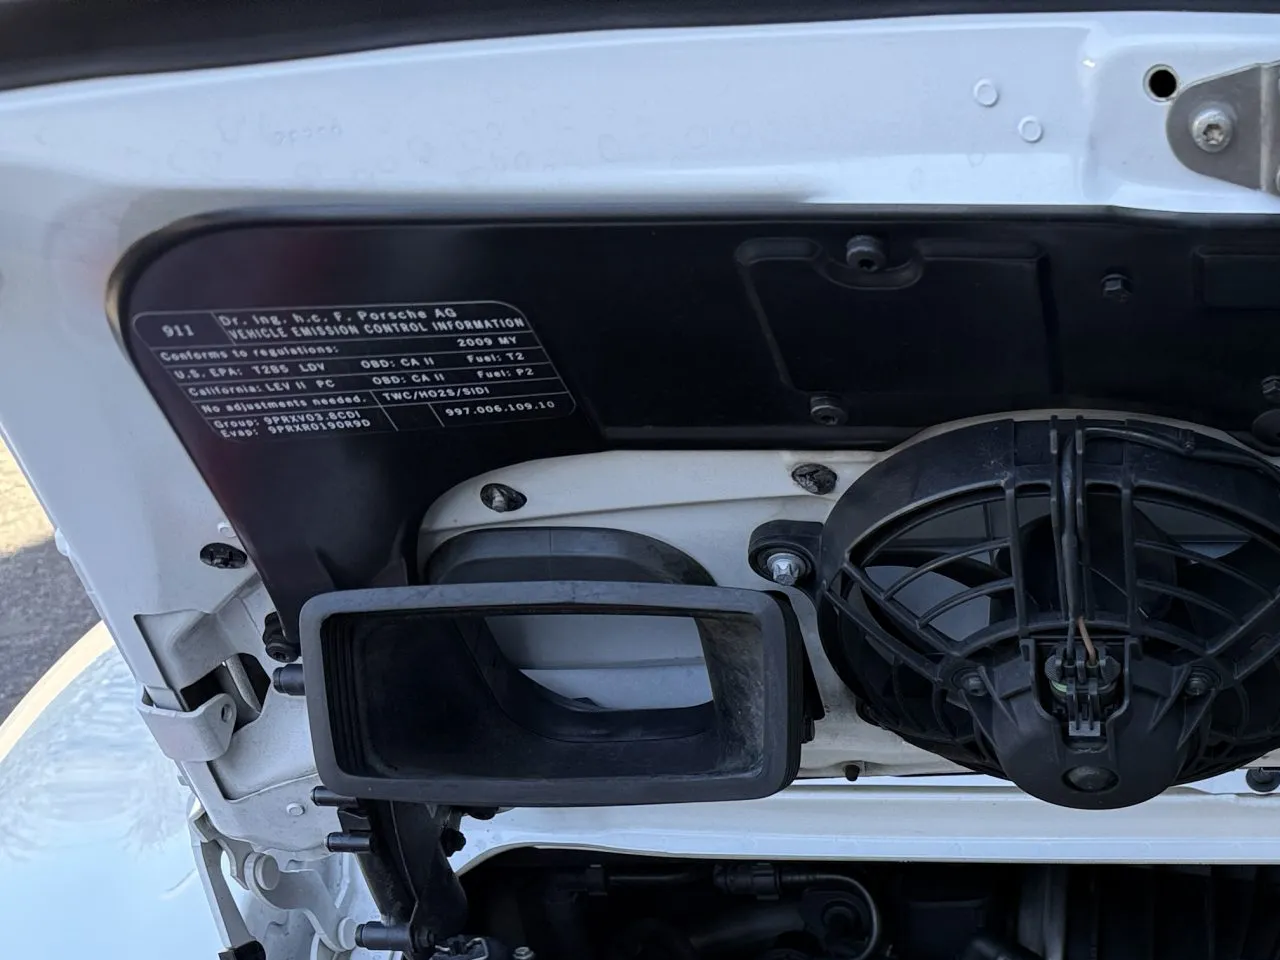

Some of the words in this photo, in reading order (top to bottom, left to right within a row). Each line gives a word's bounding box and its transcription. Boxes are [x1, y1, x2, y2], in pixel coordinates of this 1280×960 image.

[218, 315, 248, 327] Dr.
[252, 314, 287, 326] Ing.
[333, 311, 352, 322] F.
[357, 308, 428, 321] Porsche
[434, 307, 457, 318] AG
[161, 324, 194, 338] 911
[228, 326, 288, 340] VEHICLE
[291, 324, 360, 338] EMISSION
[364, 320, 428, 335] CONTROL
[432, 317, 525, 331] INFORMATION
[160, 349, 228, 362] Conforms
[232, 348, 249, 358] to
[253, 346, 339, 358] regulations:
[456, 338, 493, 347] 2009
[497, 336, 518, 345] MY
[173, 369, 206, 380] U.S.
[208, 366, 243, 377] EPA:
[298, 362, 325, 372] LDV
[360, 359, 396, 370] OBD:
[400, 358, 420, 368] CA
[466, 354, 502, 364] Fuel:
[507, 352, 525, 361] T2
[187, 384, 262, 398] California:
[265, 381, 291, 392] LEV
[316, 379, 336, 389] PC
[372, 375, 407, 386] OBD:
[411, 374, 431, 383] CA
[477, 369, 512, 379] Fuel:
[516, 367, 534, 377] P2
[201, 404, 221, 415] No
[226, 399, 308, 414] adjustments
[312, 395, 367, 407] needed.
[213, 419, 260, 431] Group:
[221, 428, 259, 439] Evap:
